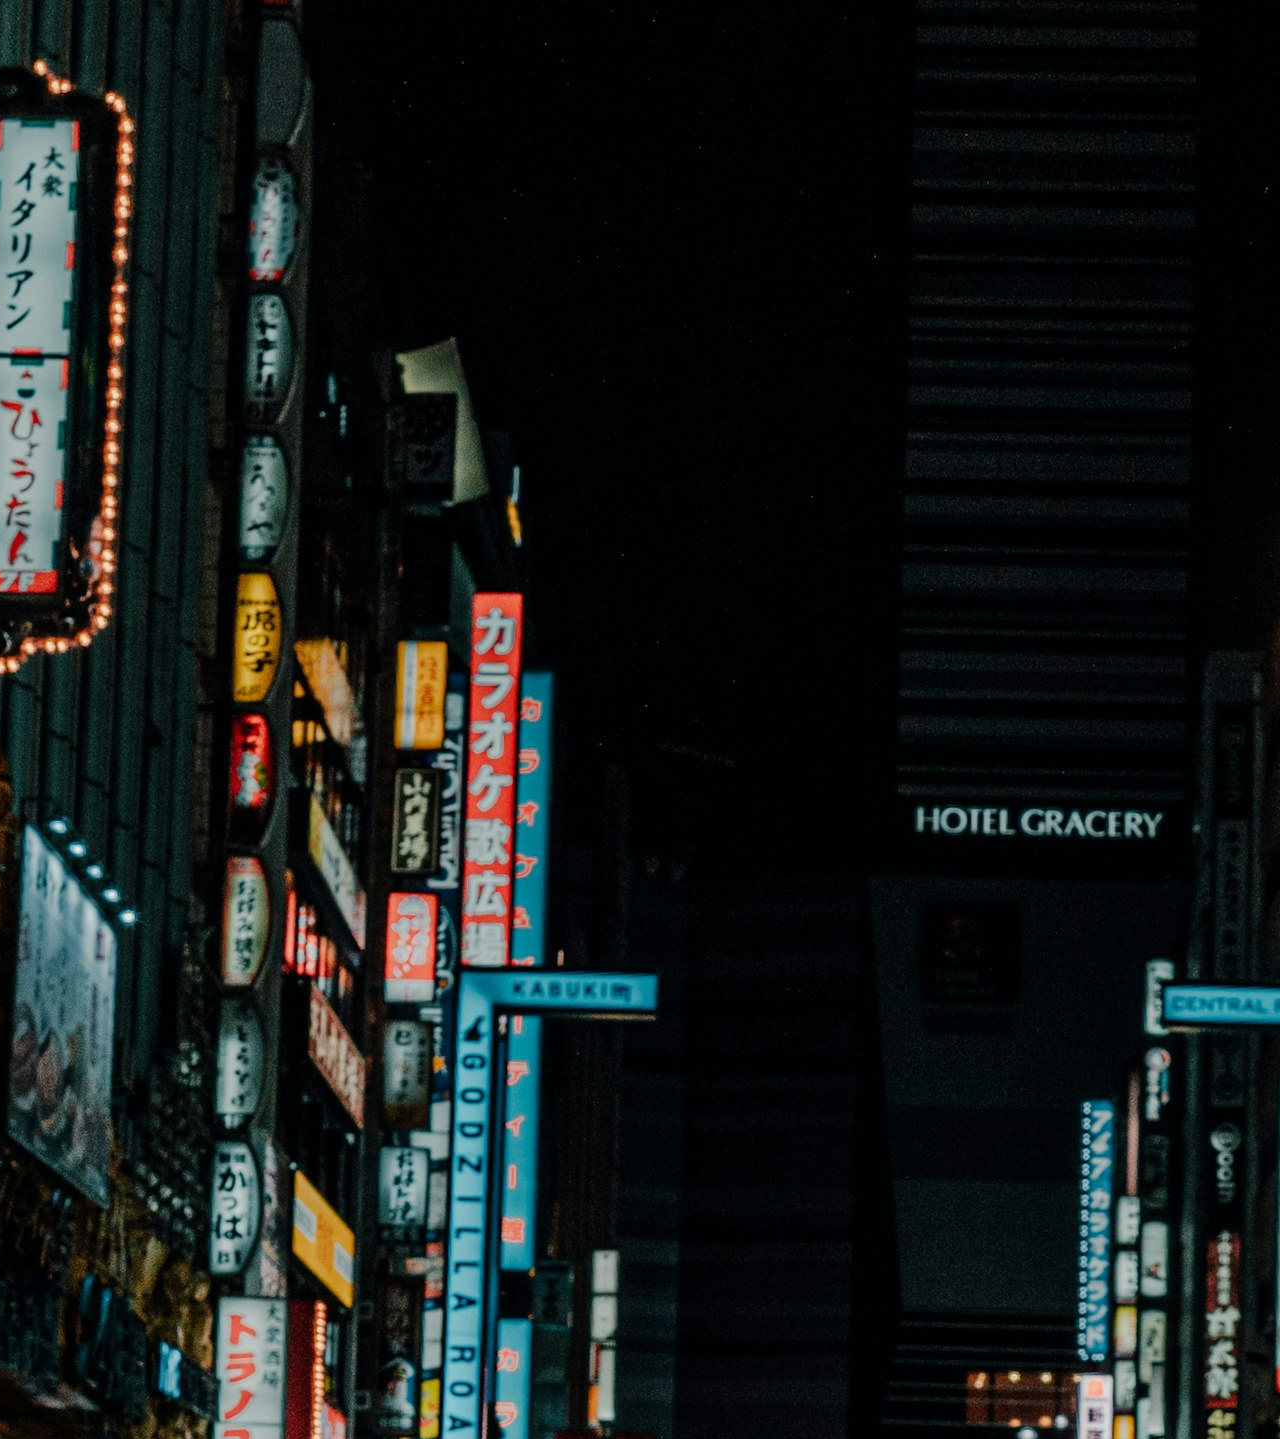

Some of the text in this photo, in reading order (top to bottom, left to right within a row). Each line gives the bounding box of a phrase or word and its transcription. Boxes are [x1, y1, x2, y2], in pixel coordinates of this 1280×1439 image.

[5, 162, 37, 330] イタリアン
[43, 146, 65, 198] 大衆
[0, 398, 43, 565] ひょうたん
[461, 606, 517, 966] カラオケ歌広場
[913, 805, 1165, 840] HOTEL GRACERY
[1172, 996, 1268, 1014] CENTRAL
[451, 1054, 487, 1311] GODZILLA
